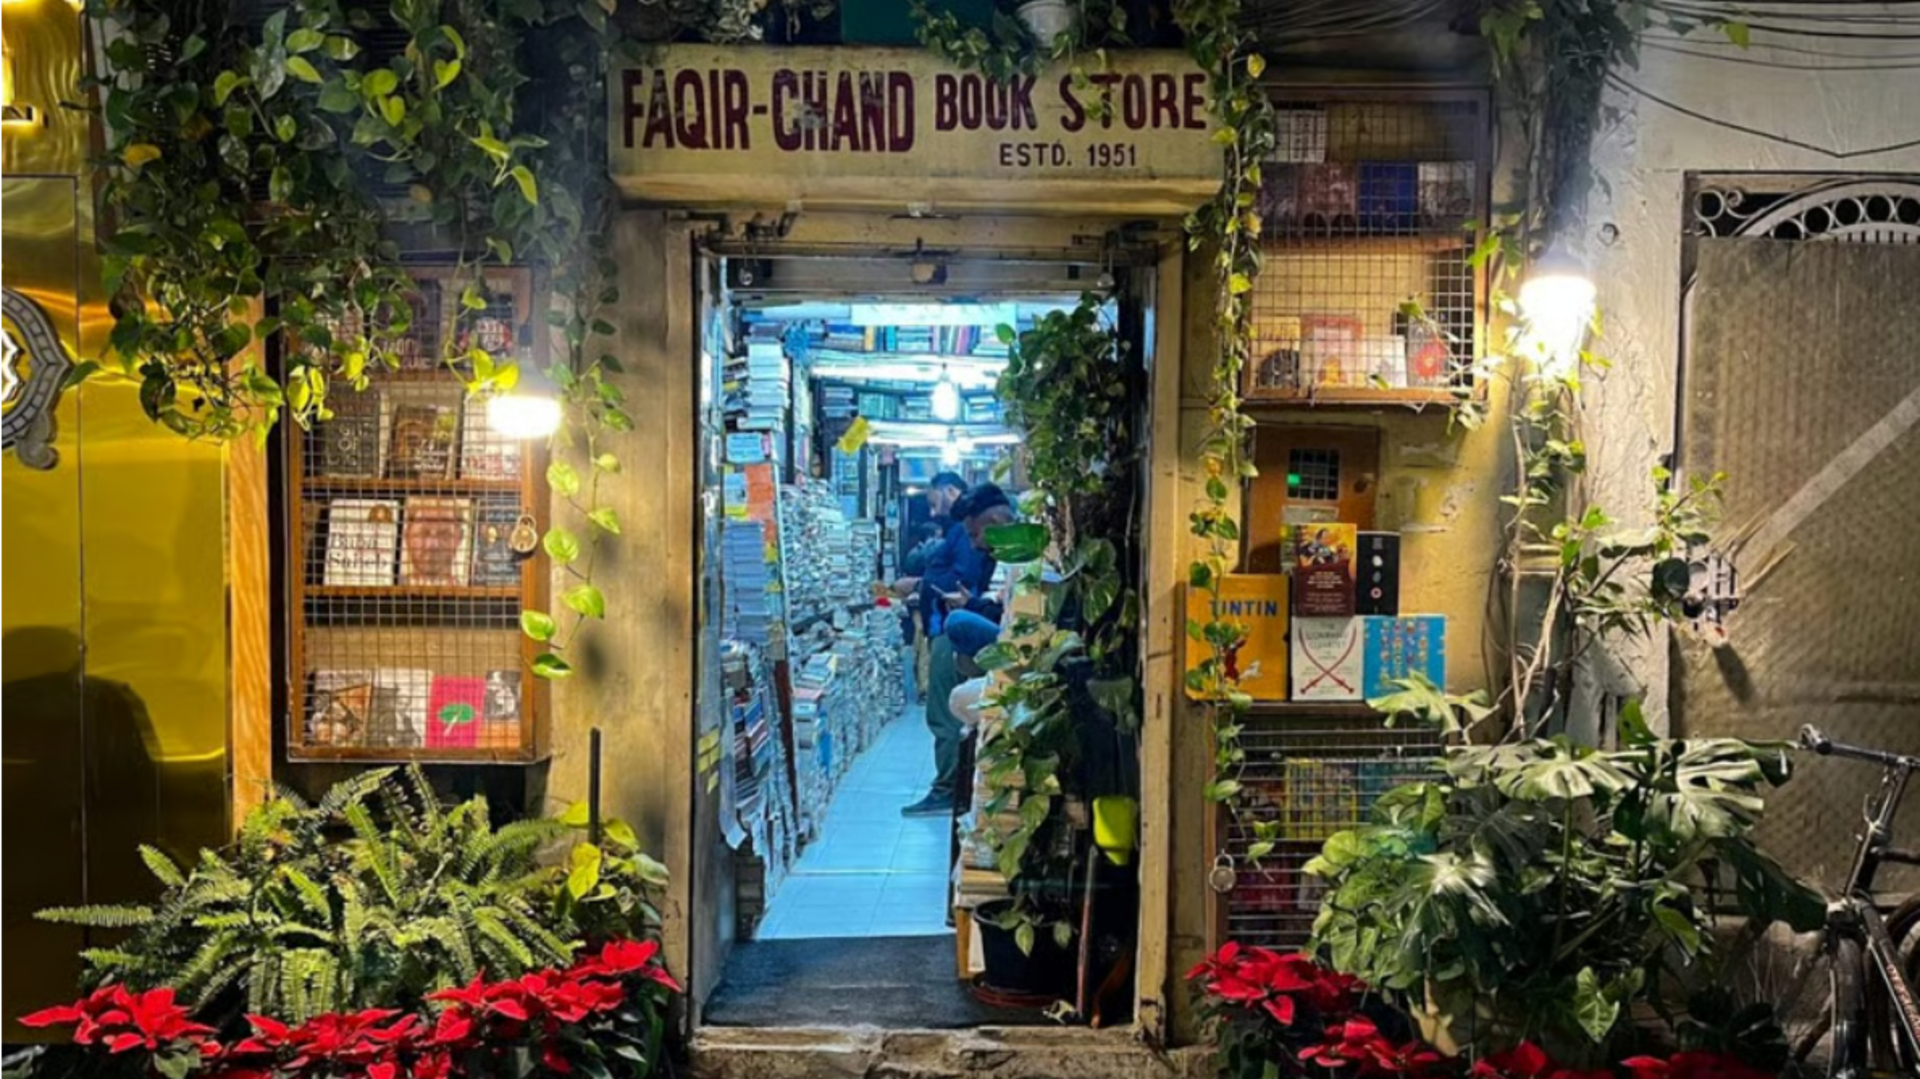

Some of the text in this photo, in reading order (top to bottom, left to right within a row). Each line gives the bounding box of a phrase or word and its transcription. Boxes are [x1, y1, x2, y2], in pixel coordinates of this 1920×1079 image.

[621, 68, 1207, 152] FAQIR-CHAND BOOK STORE
[1087, 142, 1137, 167] 1951
[1207, 599, 1278, 617] TINTIN
